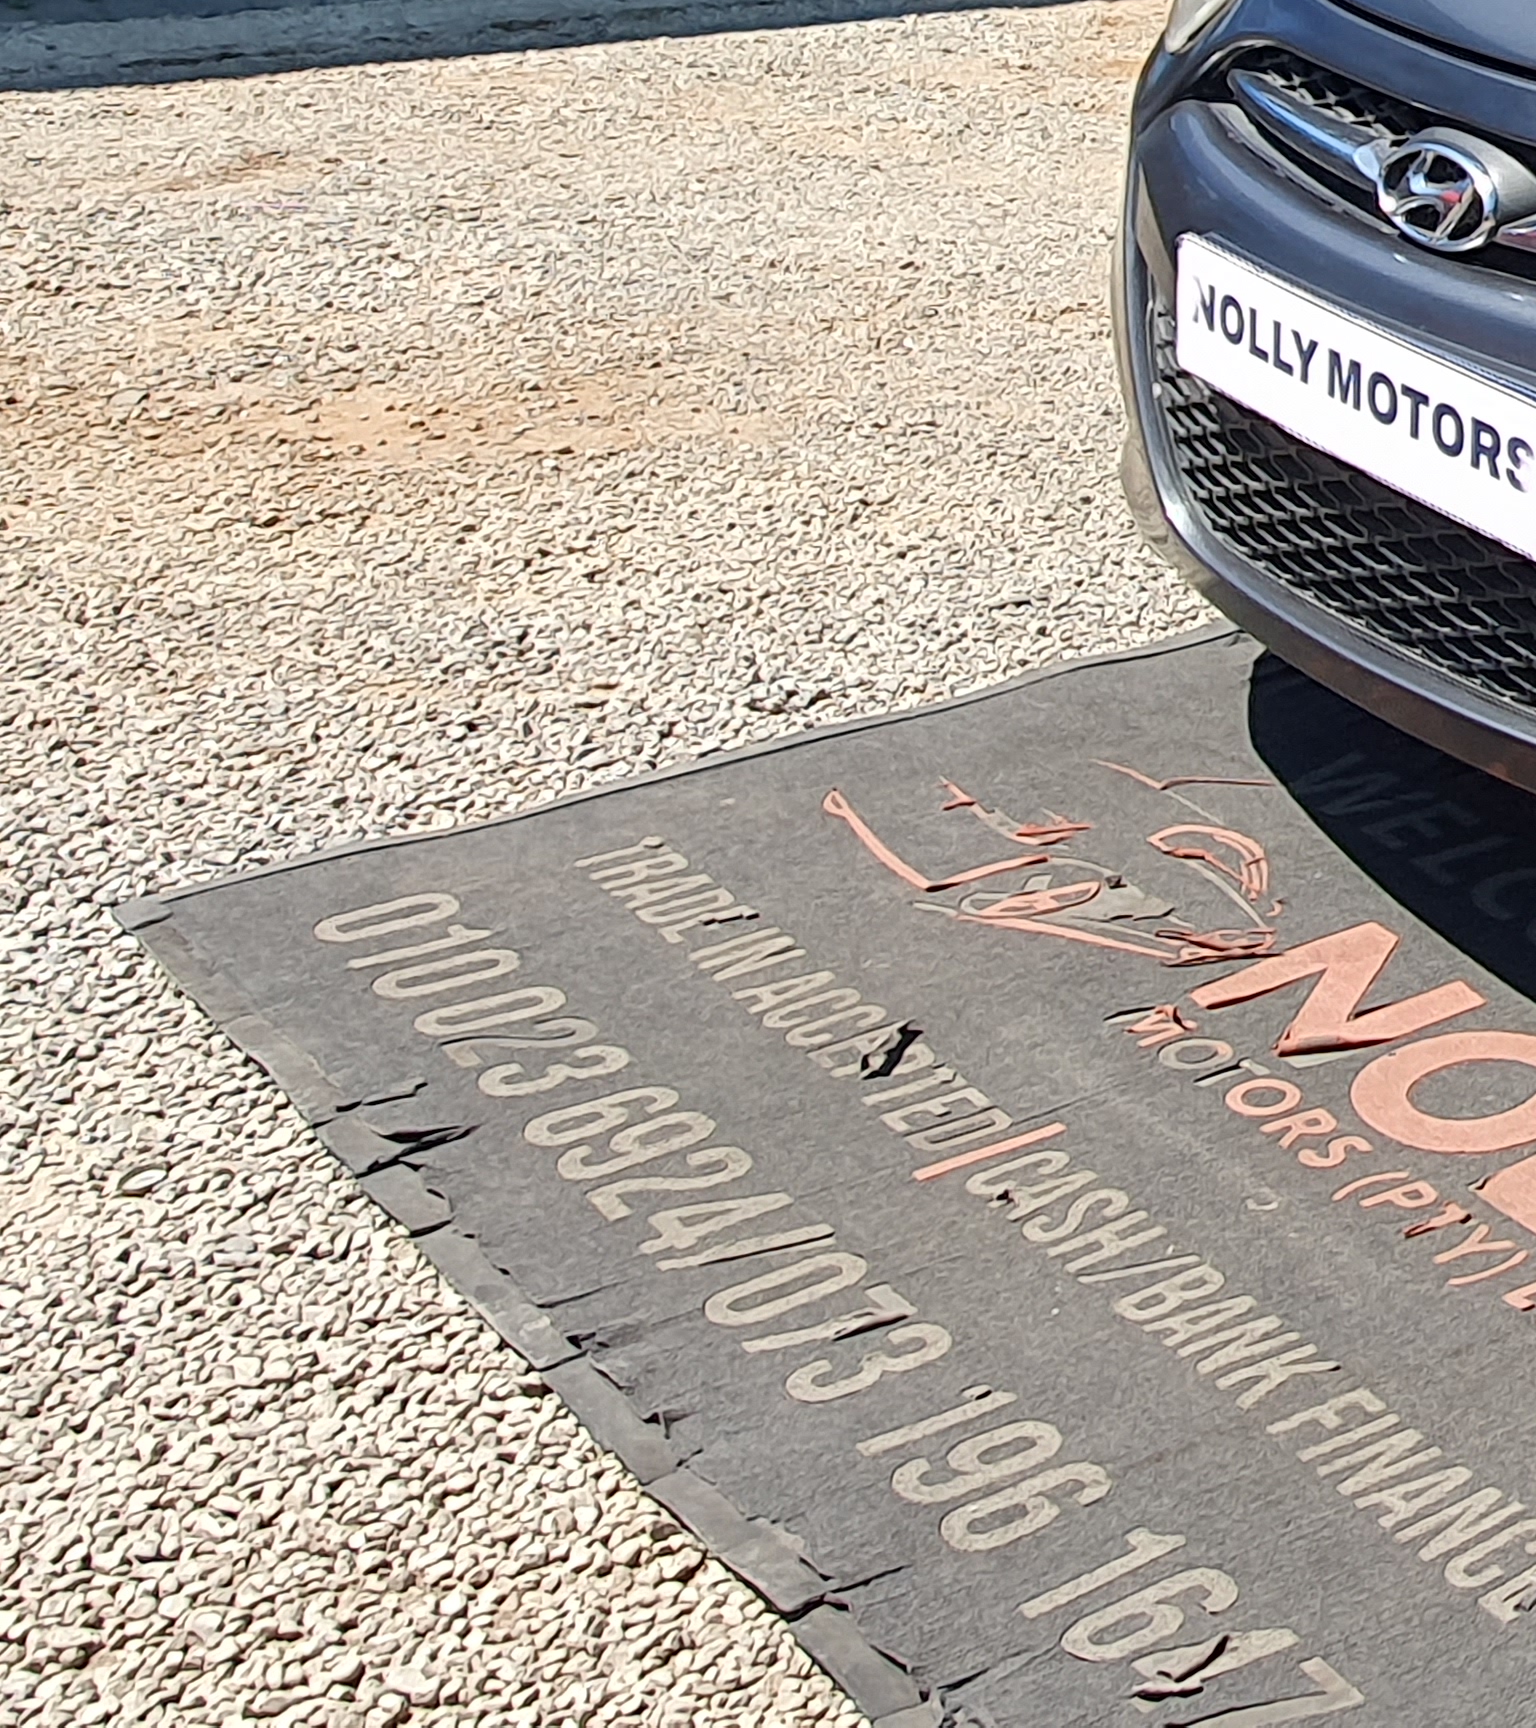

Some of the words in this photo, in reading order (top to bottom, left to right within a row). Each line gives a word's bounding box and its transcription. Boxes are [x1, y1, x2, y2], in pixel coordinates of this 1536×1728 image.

[1192, 276, 1319, 384] NOLLY
[1327, 348, 1536, 493] MOTORS
[573, 835, 760, 944] TRADE
[688, 926, 807, 983] IN
[1103, 1004, 1374, 1169] MOTORS
[1331, 1170, 1530, 1287] (PTY)
[855, 1383, 1113, 1553] 196
[1018, 1526, 1366, 1728] 1647
